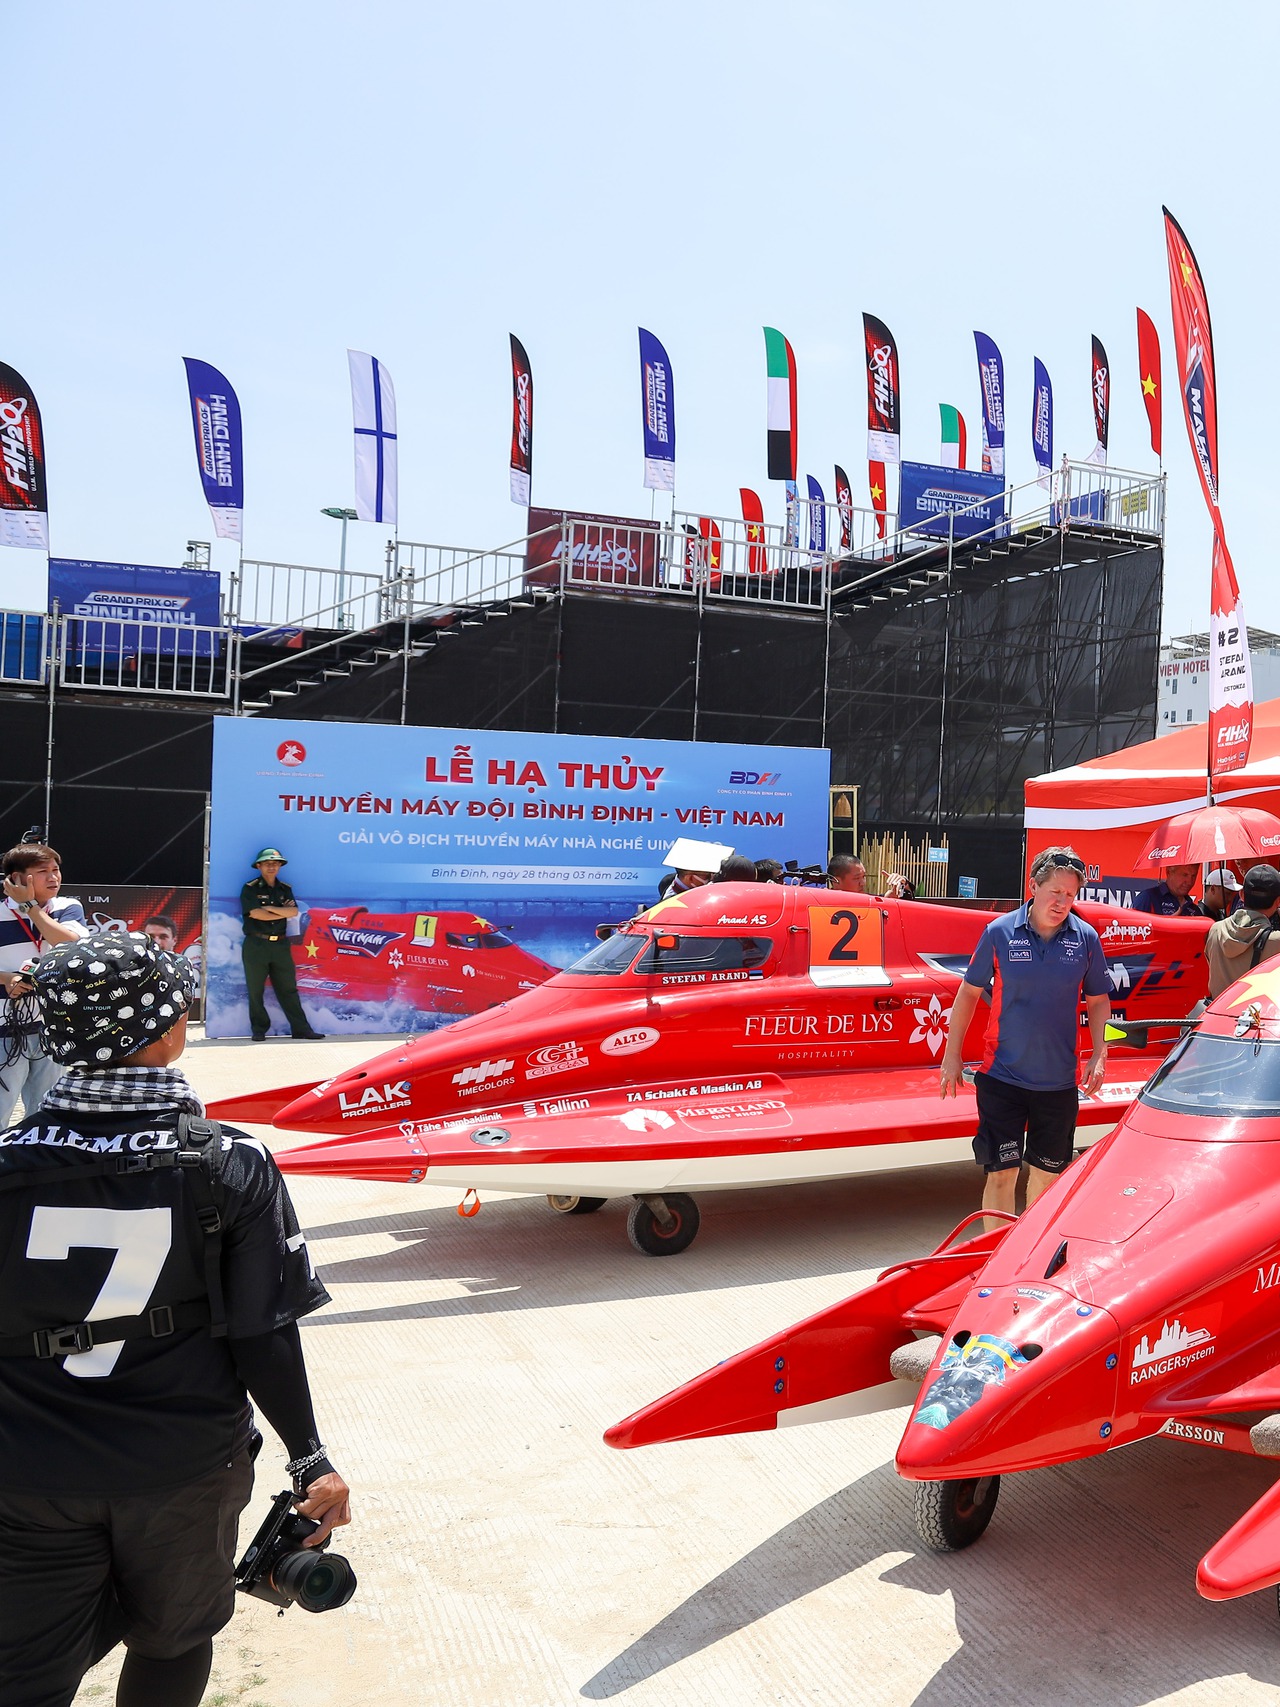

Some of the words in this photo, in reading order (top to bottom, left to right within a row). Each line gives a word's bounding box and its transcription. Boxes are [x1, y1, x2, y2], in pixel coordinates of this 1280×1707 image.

[201, 408, 209, 421] OF
[210, 394, 229, 441] DINH
[203, 421, 211, 442] PRIX
[204, 442, 213, 473] GRAND
[215, 443, 232, 487] BINH
[916, 497, 954, 513] BINH
[928, 490, 953, 499] GRAND
[954, 493, 970, 502] PRIX
[93, 594, 134, 605] GRAND
[135, 597, 162, 607] PRIX
[162, 599, 178, 607] OF
[1218, 627, 1239, 647] #2
[1160, 663, 1180, 677] VIEW
[1183, 659, 1211, 674] HOTEL
[425, 744, 474, 784] LỄ
[488, 759, 548, 793] HẠ
[558, 755, 665, 792] THỦY
[279, 792, 392, 814] THUYỀN
[401, 795, 460, 816] MÁY
[466, 798, 514, 821] ĐỘI
[523, 800, 584, 820] BÌNH
[591, 806, 653, 825] ĐỊNH
[675, 806, 726, 828] VIỆT
[732, 811, 784, 827] NAM
[338, 829, 374, 844] GIẢI
[376, 830, 404, 845] VÔ
[408, 832, 450, 848] ĐỊCH
[454, 831, 520, 848] THUYỀN
[524, 834, 561, 848] MÁY
[563, 834, 597, 849] NHÀ
[601, 835, 643, 850] NGHỀ
[647, 841, 674, 850] UIM
[431, 868, 457, 878] Bình
[499, 869, 520, 881] ngày
[522, 870, 535, 878] 28
[540, 870, 570, 882] tháng
[572, 871, 585, 880] 03
[588, 870, 612, 880] năm
[614, 871, 639, 880] 2024
[88, 895, 110, 903] UIM
[717, 914, 748, 926] Arand
[750, 914, 767, 925] AS
[332, 928, 387, 946] VIETNAM
[829, 910, 859, 961] 2
[662, 973, 706, 985] STEFAN
[711, 971, 749, 983] ARAND
[903, 997, 921, 1006] OFF
[744, 1015, 819, 1037] FLEUR
[827, 1014, 856, 1035] DE
[861, 1012, 894, 1033] LYS
[614, 1032, 647, 1047] ALTO
[777, 1049, 856, 1060] HOSPITALITY
[338, 1081, 411, 1111] LAK
[457, 1076, 515, 1098] TIMECOLORS
[626, 1093, 643, 1103] TA
[645, 1089, 688, 1101] Schakt
[689, 1087, 699, 1096] &
[700, 1082, 744, 1095] Maskin
[746, 1080, 763, 1090] AB
[342, 1099, 412, 1119] PROPELLERS
[540, 1098, 590, 1116] Tallinn
[675, 1100, 786, 1119] MERRYLAND
[443, 1112, 503, 1128] hambakliinik
[26, 1206, 172, 1377] 7
[1130, 1345, 1215, 1385] RANGERsystem
